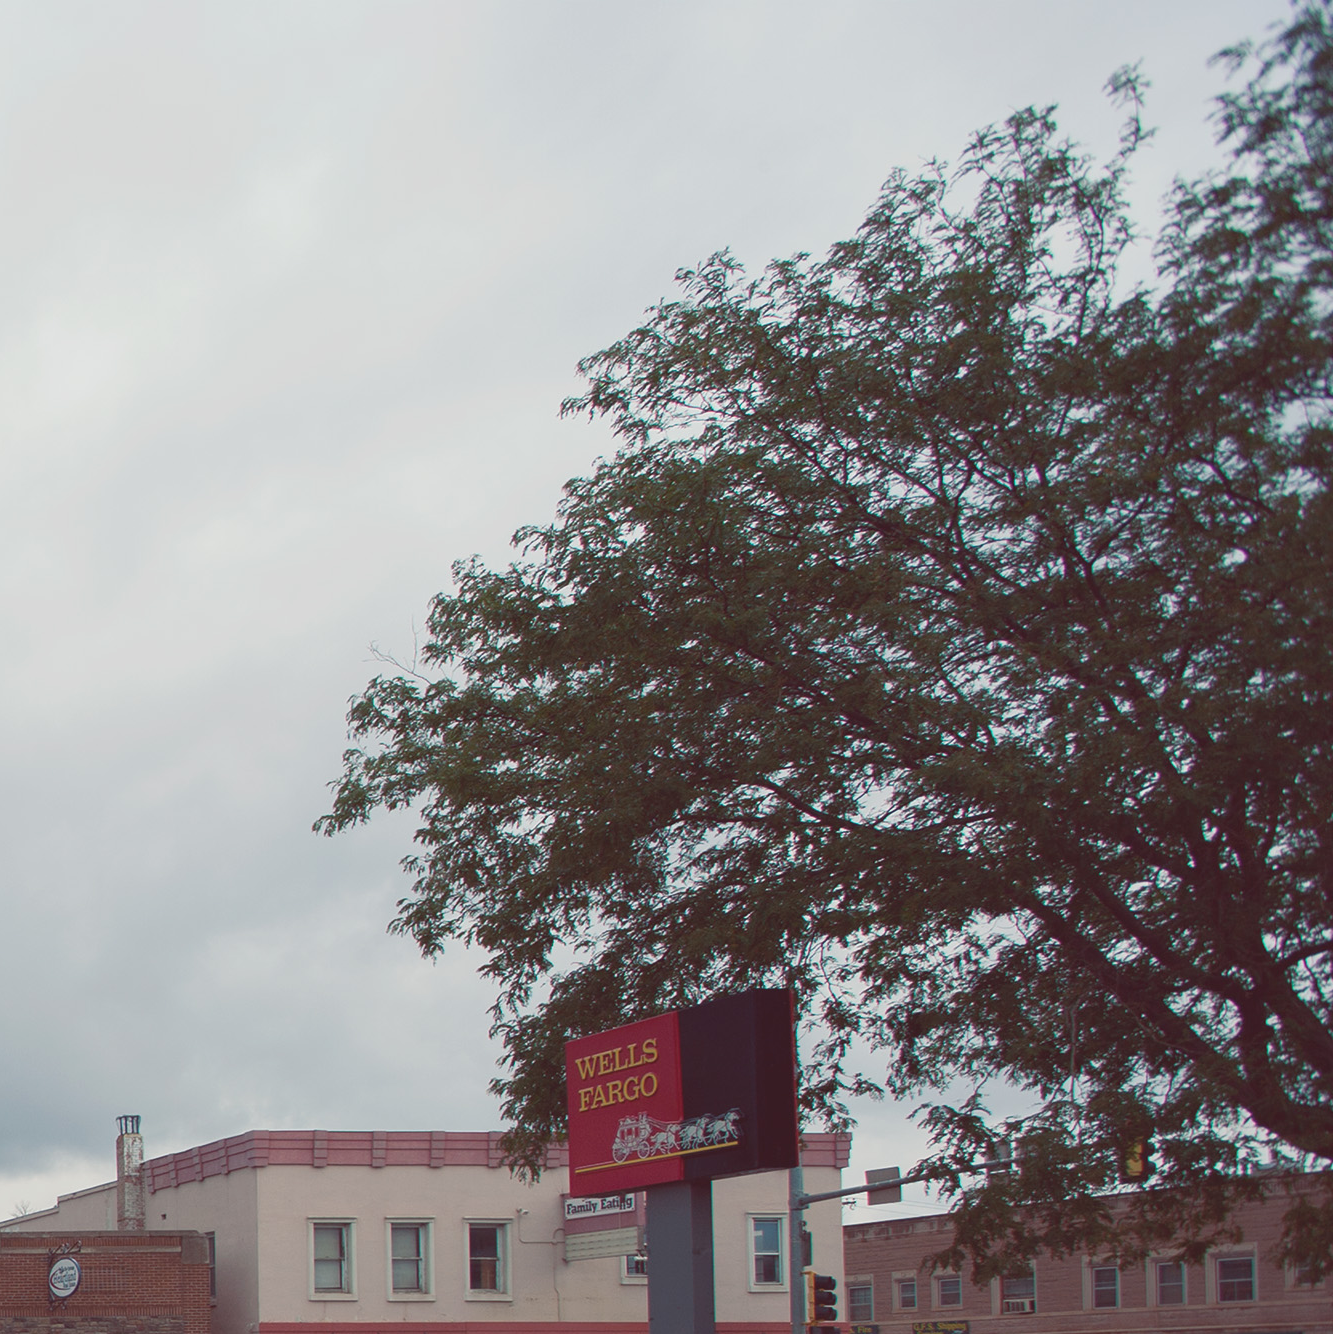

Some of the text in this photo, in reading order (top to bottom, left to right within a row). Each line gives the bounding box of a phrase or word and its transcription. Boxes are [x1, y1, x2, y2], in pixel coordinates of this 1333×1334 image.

[574, 1037, 658, 1080] WELLS
[578, 1072, 658, 1112] FARGO
[566, 1200, 597, 1215] Family
